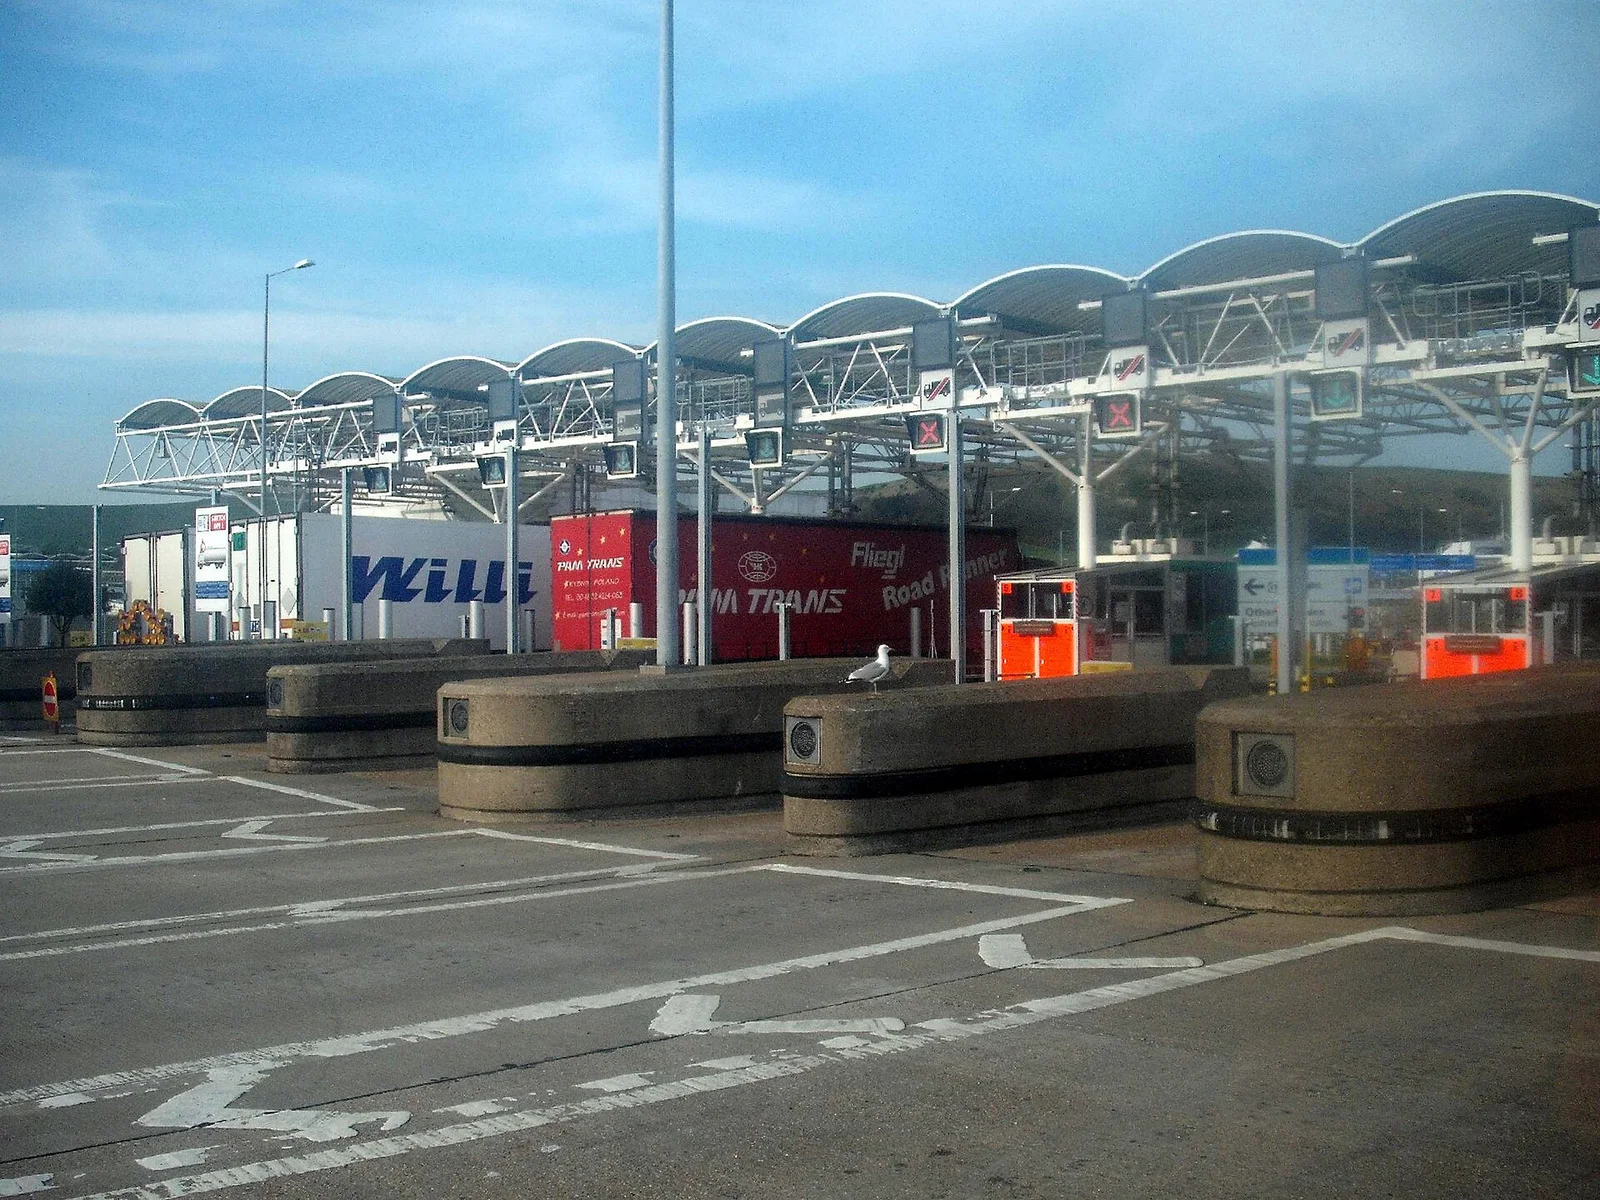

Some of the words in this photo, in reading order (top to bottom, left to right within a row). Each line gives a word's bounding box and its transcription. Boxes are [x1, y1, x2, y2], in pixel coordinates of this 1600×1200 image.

[557, 560, 583, 572] PAM
[587, 557, 624, 569] TRANS
[851, 541, 906, 580] Fliegl
[940, 548, 1008, 589] Rnner
[352, 556, 538, 604] Willi
[883, 570, 935, 611] Road
[1003, 583, 1010, 592] 5
[1065, 582, 1071, 591] 6
[748, 588, 847, 615] TRANS
